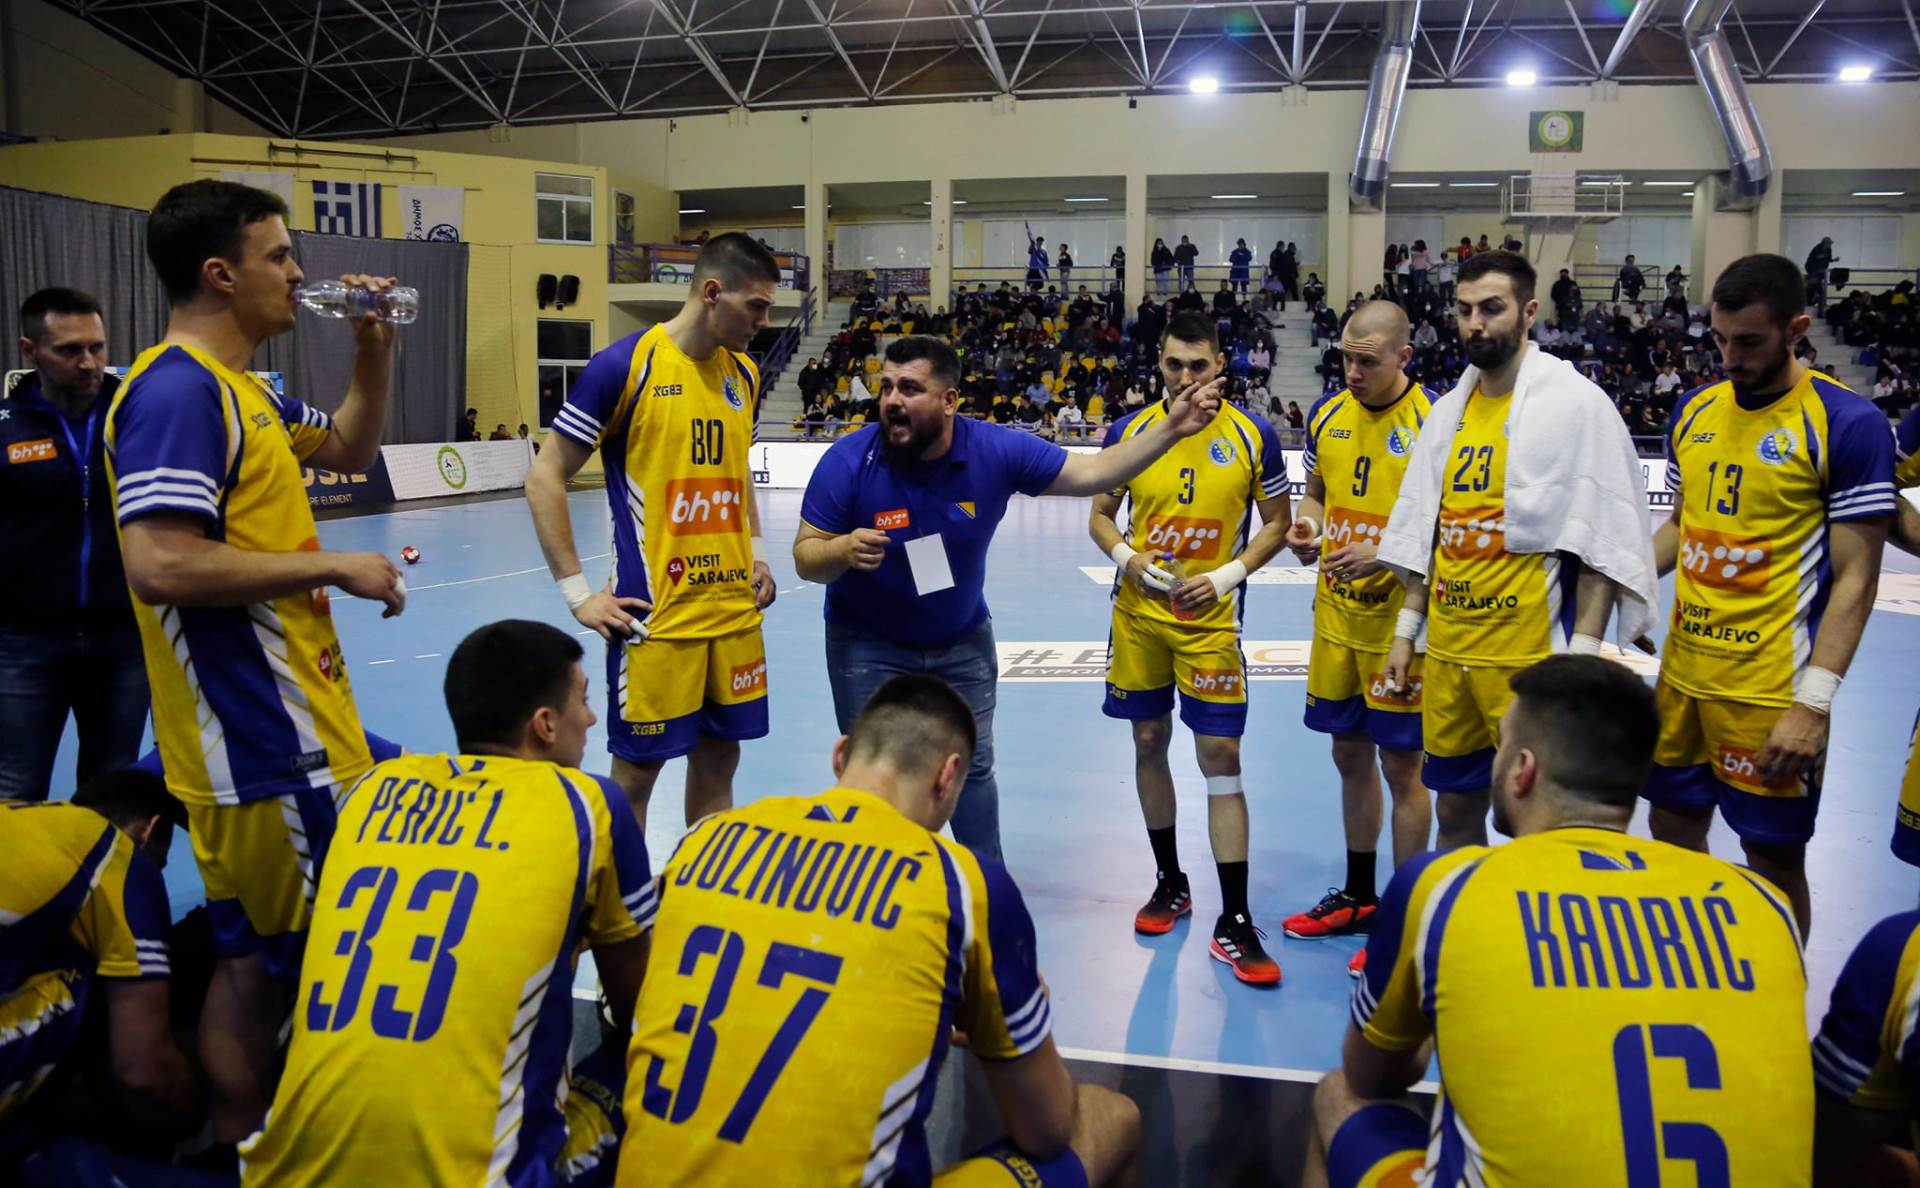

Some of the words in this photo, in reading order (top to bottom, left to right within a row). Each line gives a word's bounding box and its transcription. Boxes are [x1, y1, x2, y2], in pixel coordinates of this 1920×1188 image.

[691, 418, 724, 466] 80
[1178, 467, 1195, 505] 3
[1352, 455, 1372, 497] 9
[1453, 445, 1494, 492] 23
[1706, 461, 1743, 516] 13
[686, 554, 721, 569] VISIT
[1445, 595, 1518, 610] SARAJEVO
[1682, 601, 1712, 620] VISIT
[1682, 621, 1760, 643] ARAJEVO
[1724, 753, 1754, 776] bh
[474, 789, 510, 851] L.
[675, 820, 932, 931] JOZINOVIĆ
[306, 866, 479, 1042] 33
[1516, 881, 1755, 992] KADRIĆ
[641, 924, 844, 1144] 37
[1612, 1023, 1731, 1188] 6
